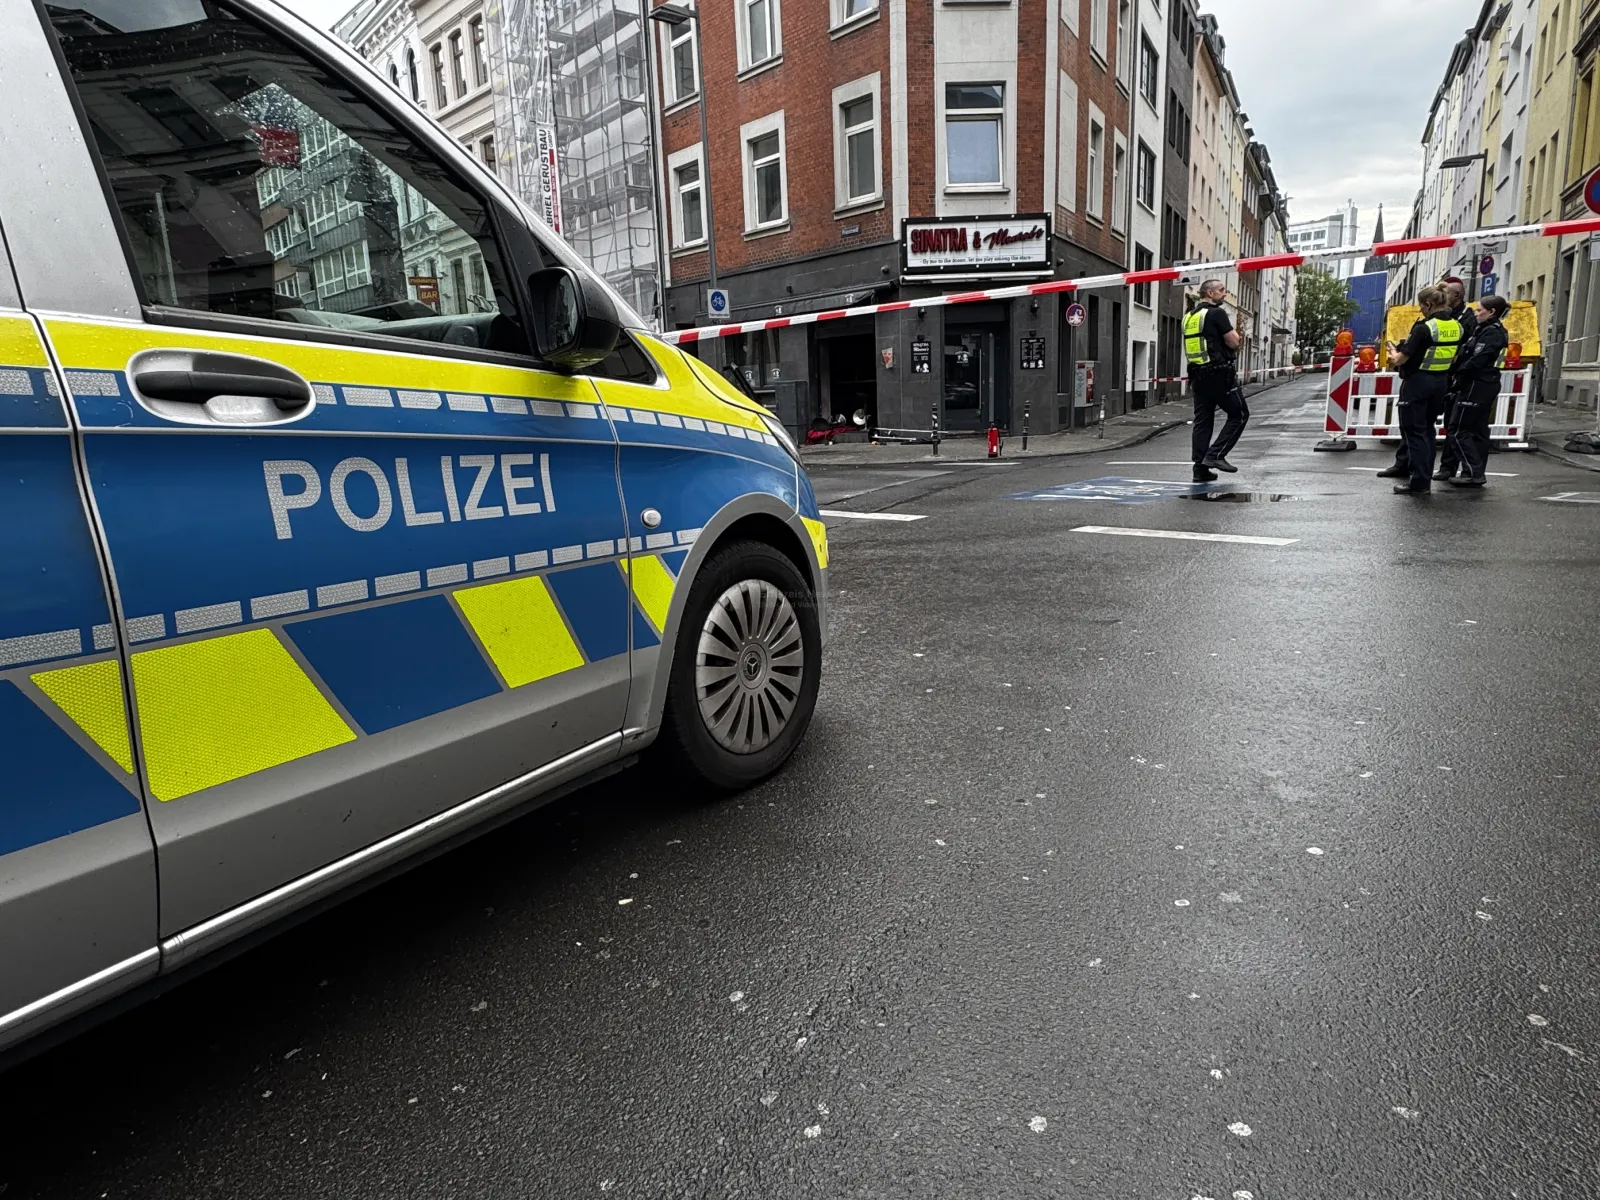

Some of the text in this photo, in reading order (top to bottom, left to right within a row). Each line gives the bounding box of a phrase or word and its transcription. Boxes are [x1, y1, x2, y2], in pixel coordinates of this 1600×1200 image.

[910, 227, 968, 254] SINATRA
[972, 230, 982, 249] &
[421, 290, 438, 299] BAR
[263, 453, 556, 539] POLIZEI
